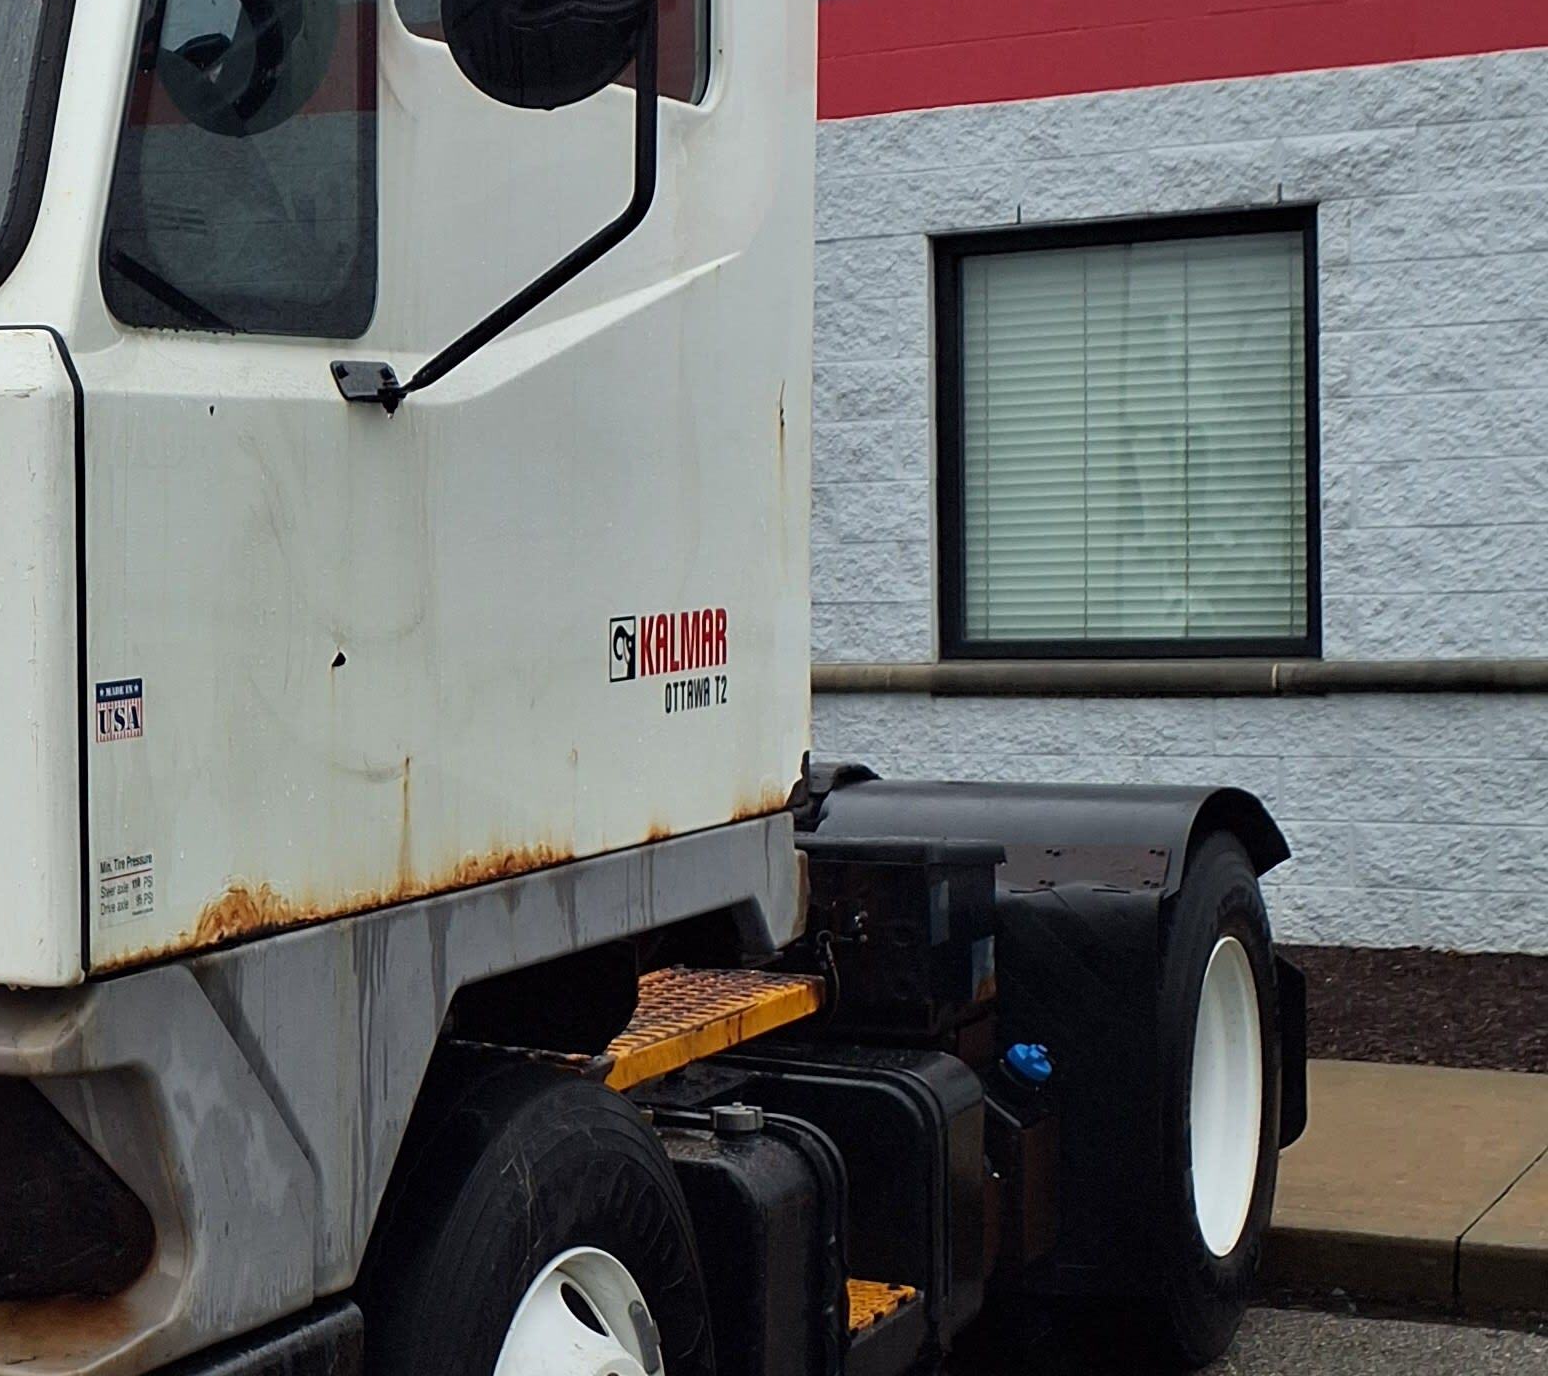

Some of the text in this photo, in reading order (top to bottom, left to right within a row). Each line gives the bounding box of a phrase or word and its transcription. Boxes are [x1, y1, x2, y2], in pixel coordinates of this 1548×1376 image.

[640, 608, 728, 677] KALMAR
[105, 684, 133, 697] MADE IN
[664, 675, 728, 714] OTTAWA T2
[99, 705, 140, 735] USA
[126, 853, 152, 869] Pressure
